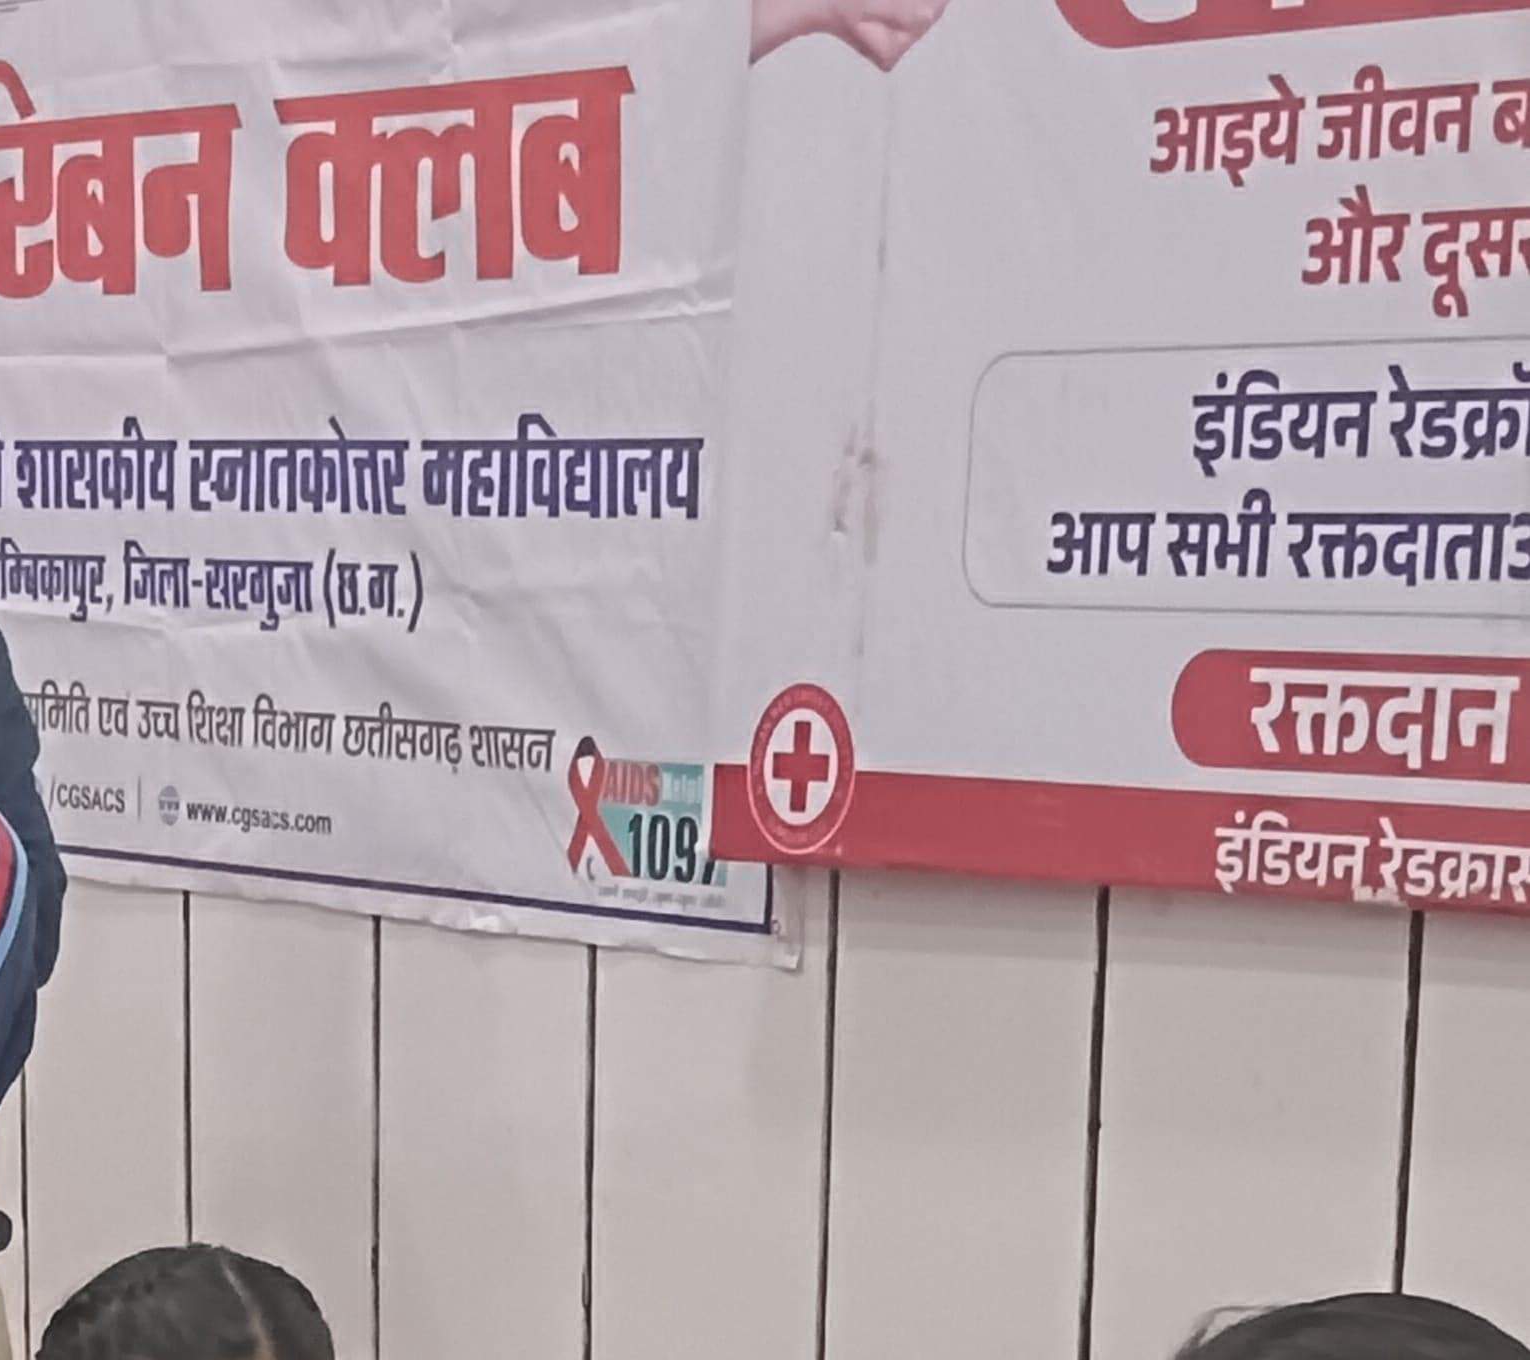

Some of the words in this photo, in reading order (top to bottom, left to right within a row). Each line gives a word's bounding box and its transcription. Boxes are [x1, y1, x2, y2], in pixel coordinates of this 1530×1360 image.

[273, 66, 636, 287] क्लब
[1150, 74, 1306, 187] आइये
[1317, 64, 1480, 161] जीवन
[1301, 184, 1411, 285] और
[14, 415, 177, 512] शासकीय
[421, 413, 704, 519] महाविद्यालय
[1192, 368, 1377, 477] इंडियन
[1046, 510, 1156, 577] आप
[1166, 487, 1276, 580] सभी
[136, 699, 179, 741] उच्च
[186, 689, 245, 747] शिक्षा
[253, 692, 336, 754] विभाग
[343, 702, 462, 774] छत्तीसगढ़
[470, 724, 556, 772] शासन
[1249, 667, 1521, 770] रक्तदान
[186, 801, 333, 835] www.cgsacs.com
[1214, 809, 1370, 898] इंडियन
